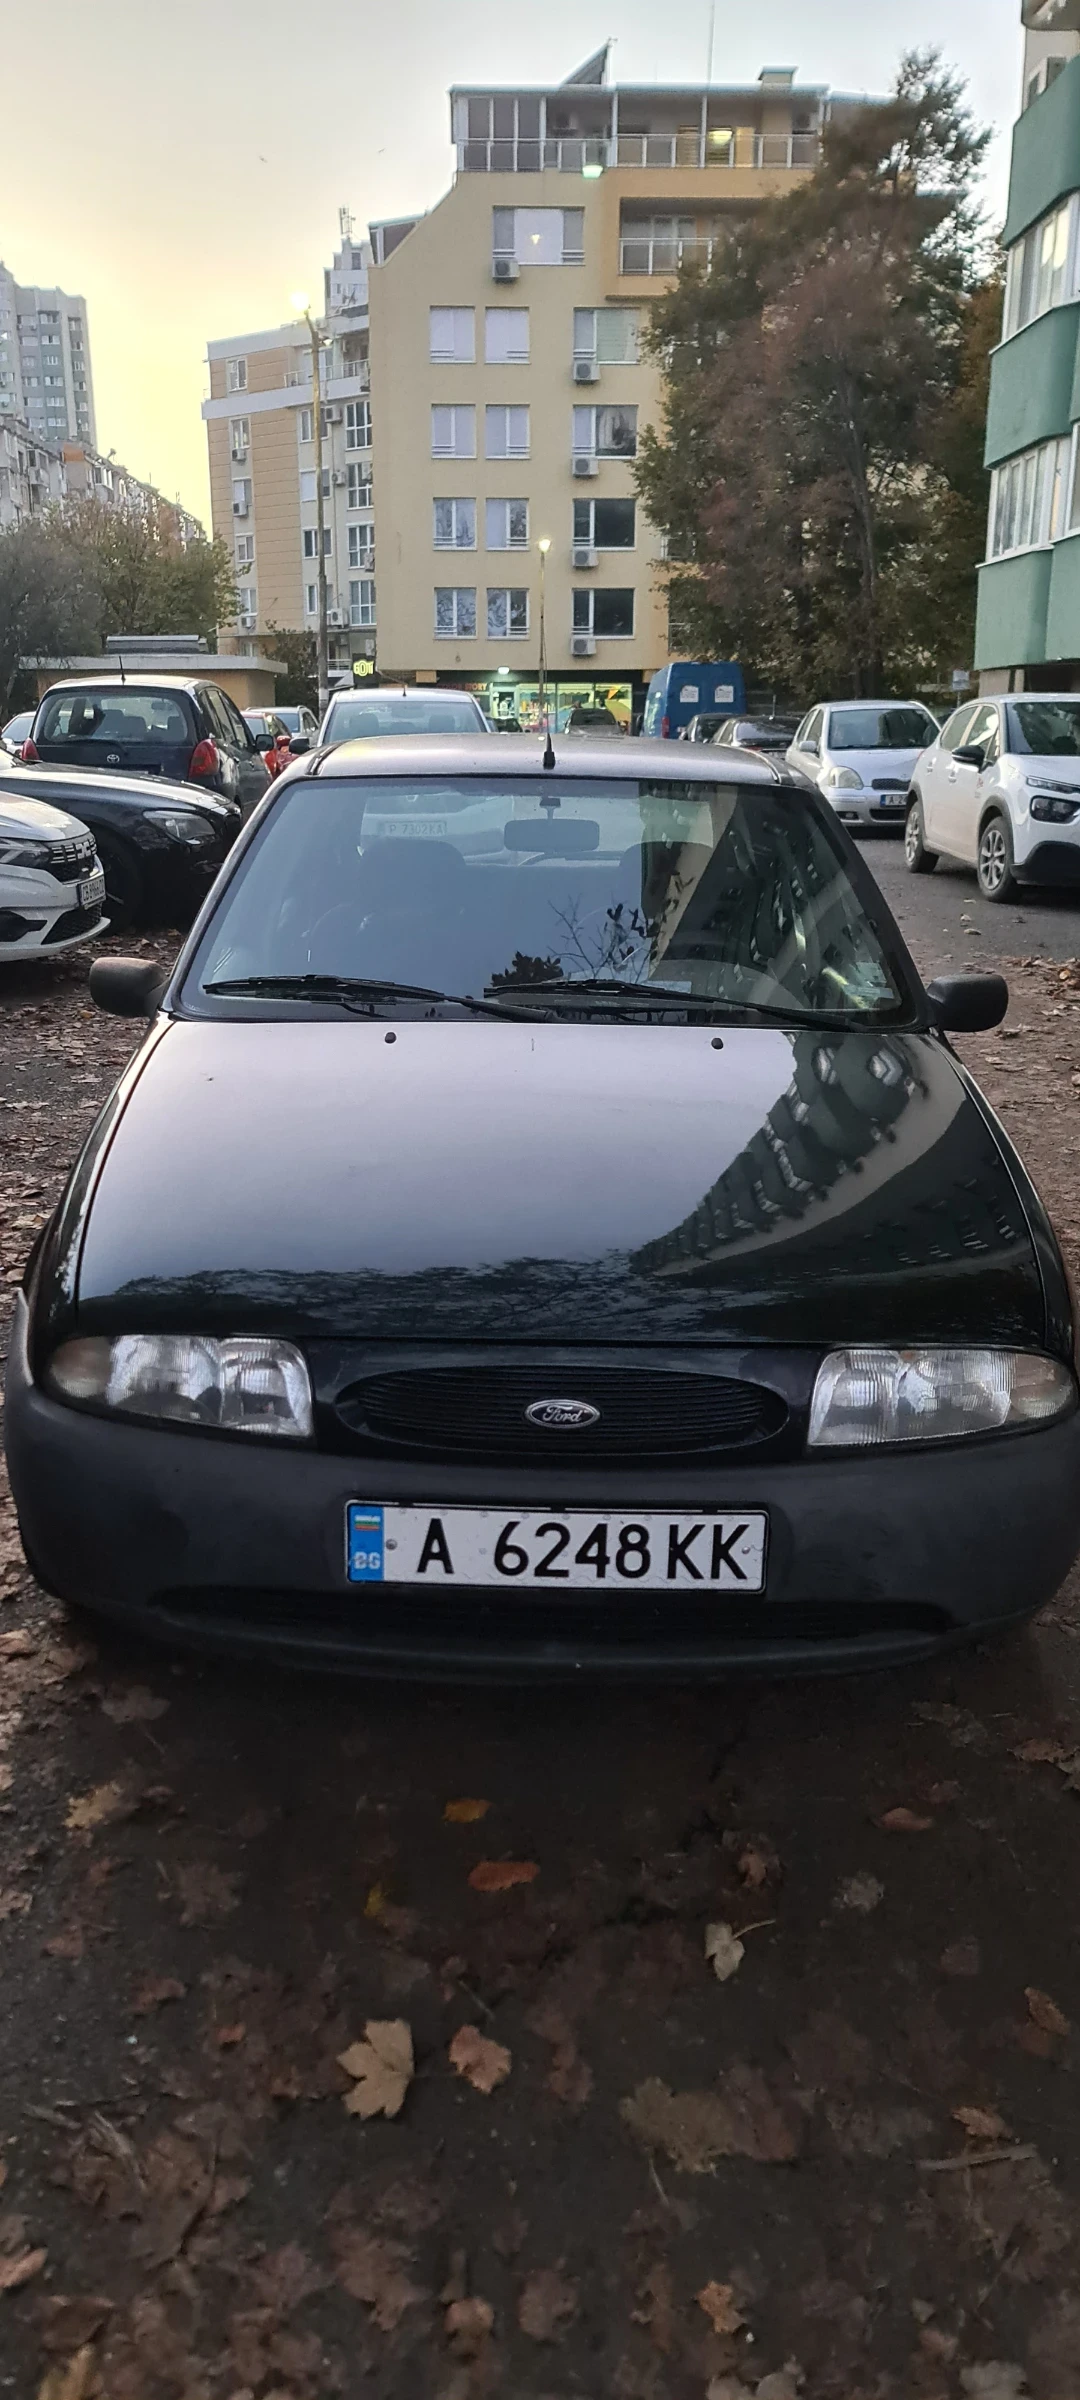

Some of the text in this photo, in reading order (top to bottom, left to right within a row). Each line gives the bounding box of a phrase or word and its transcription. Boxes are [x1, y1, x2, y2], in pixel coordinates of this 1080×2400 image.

[542, 1404, 582, 1422] Ford
[416, 1517, 455, 1574] A
[354, 1551, 381, 1569] BG
